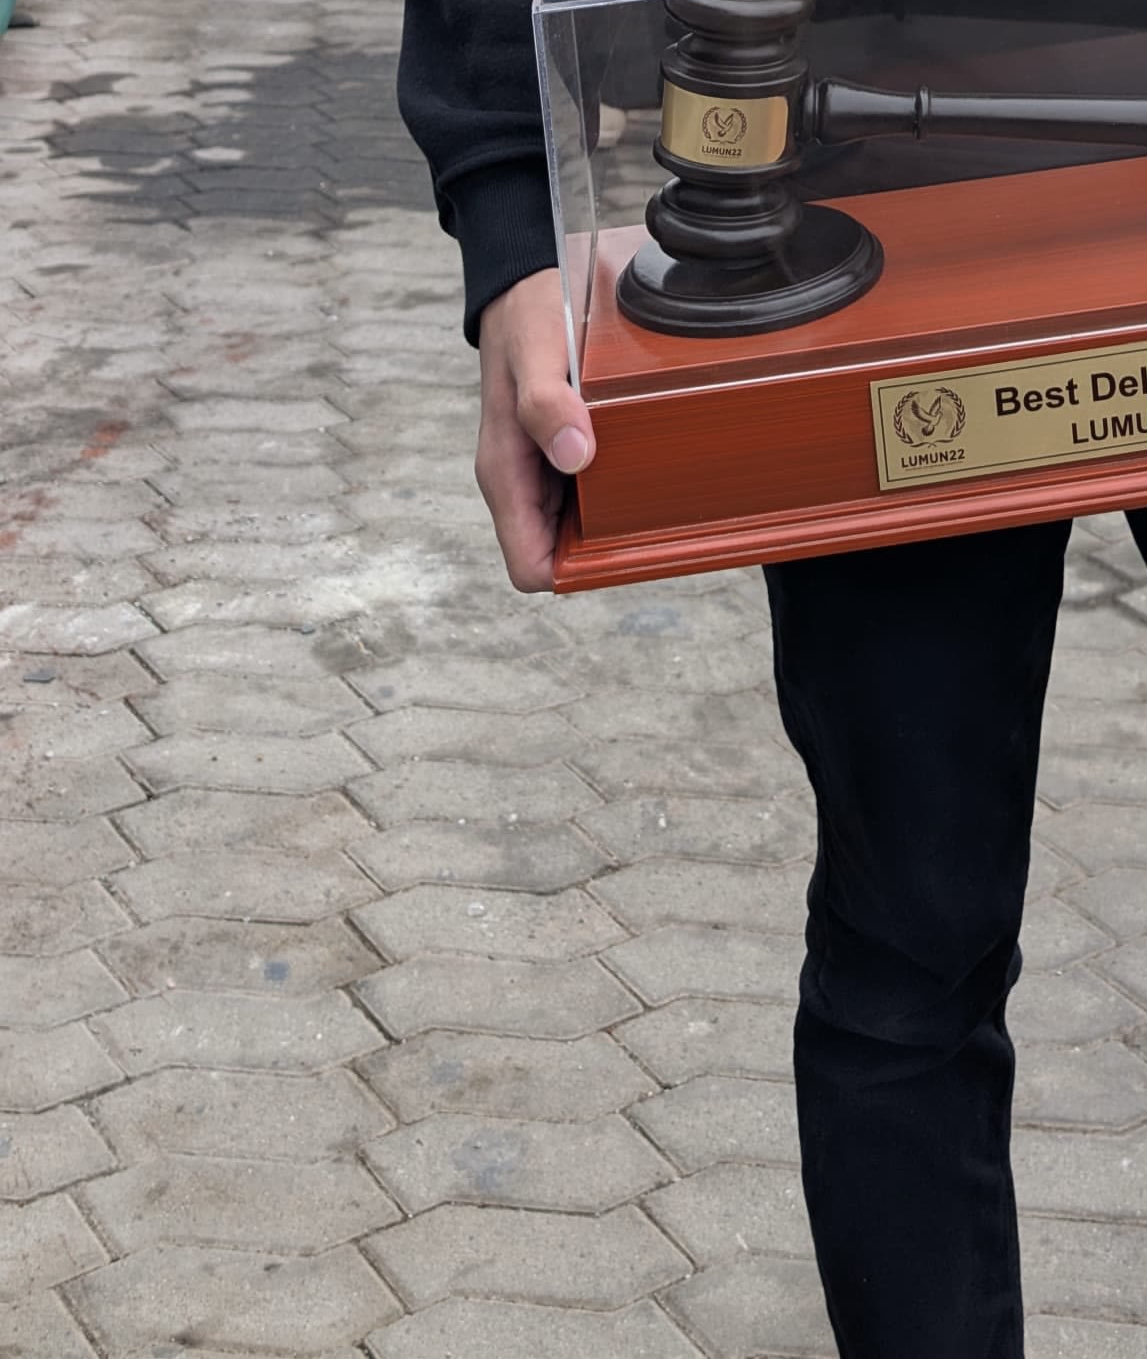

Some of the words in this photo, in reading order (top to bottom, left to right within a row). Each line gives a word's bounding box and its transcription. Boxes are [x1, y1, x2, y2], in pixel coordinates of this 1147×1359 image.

[701, 145, 742, 156] LUMUN22
[994, 377, 1080, 417] Best
[900, 448, 966, 469] LUMUN22
